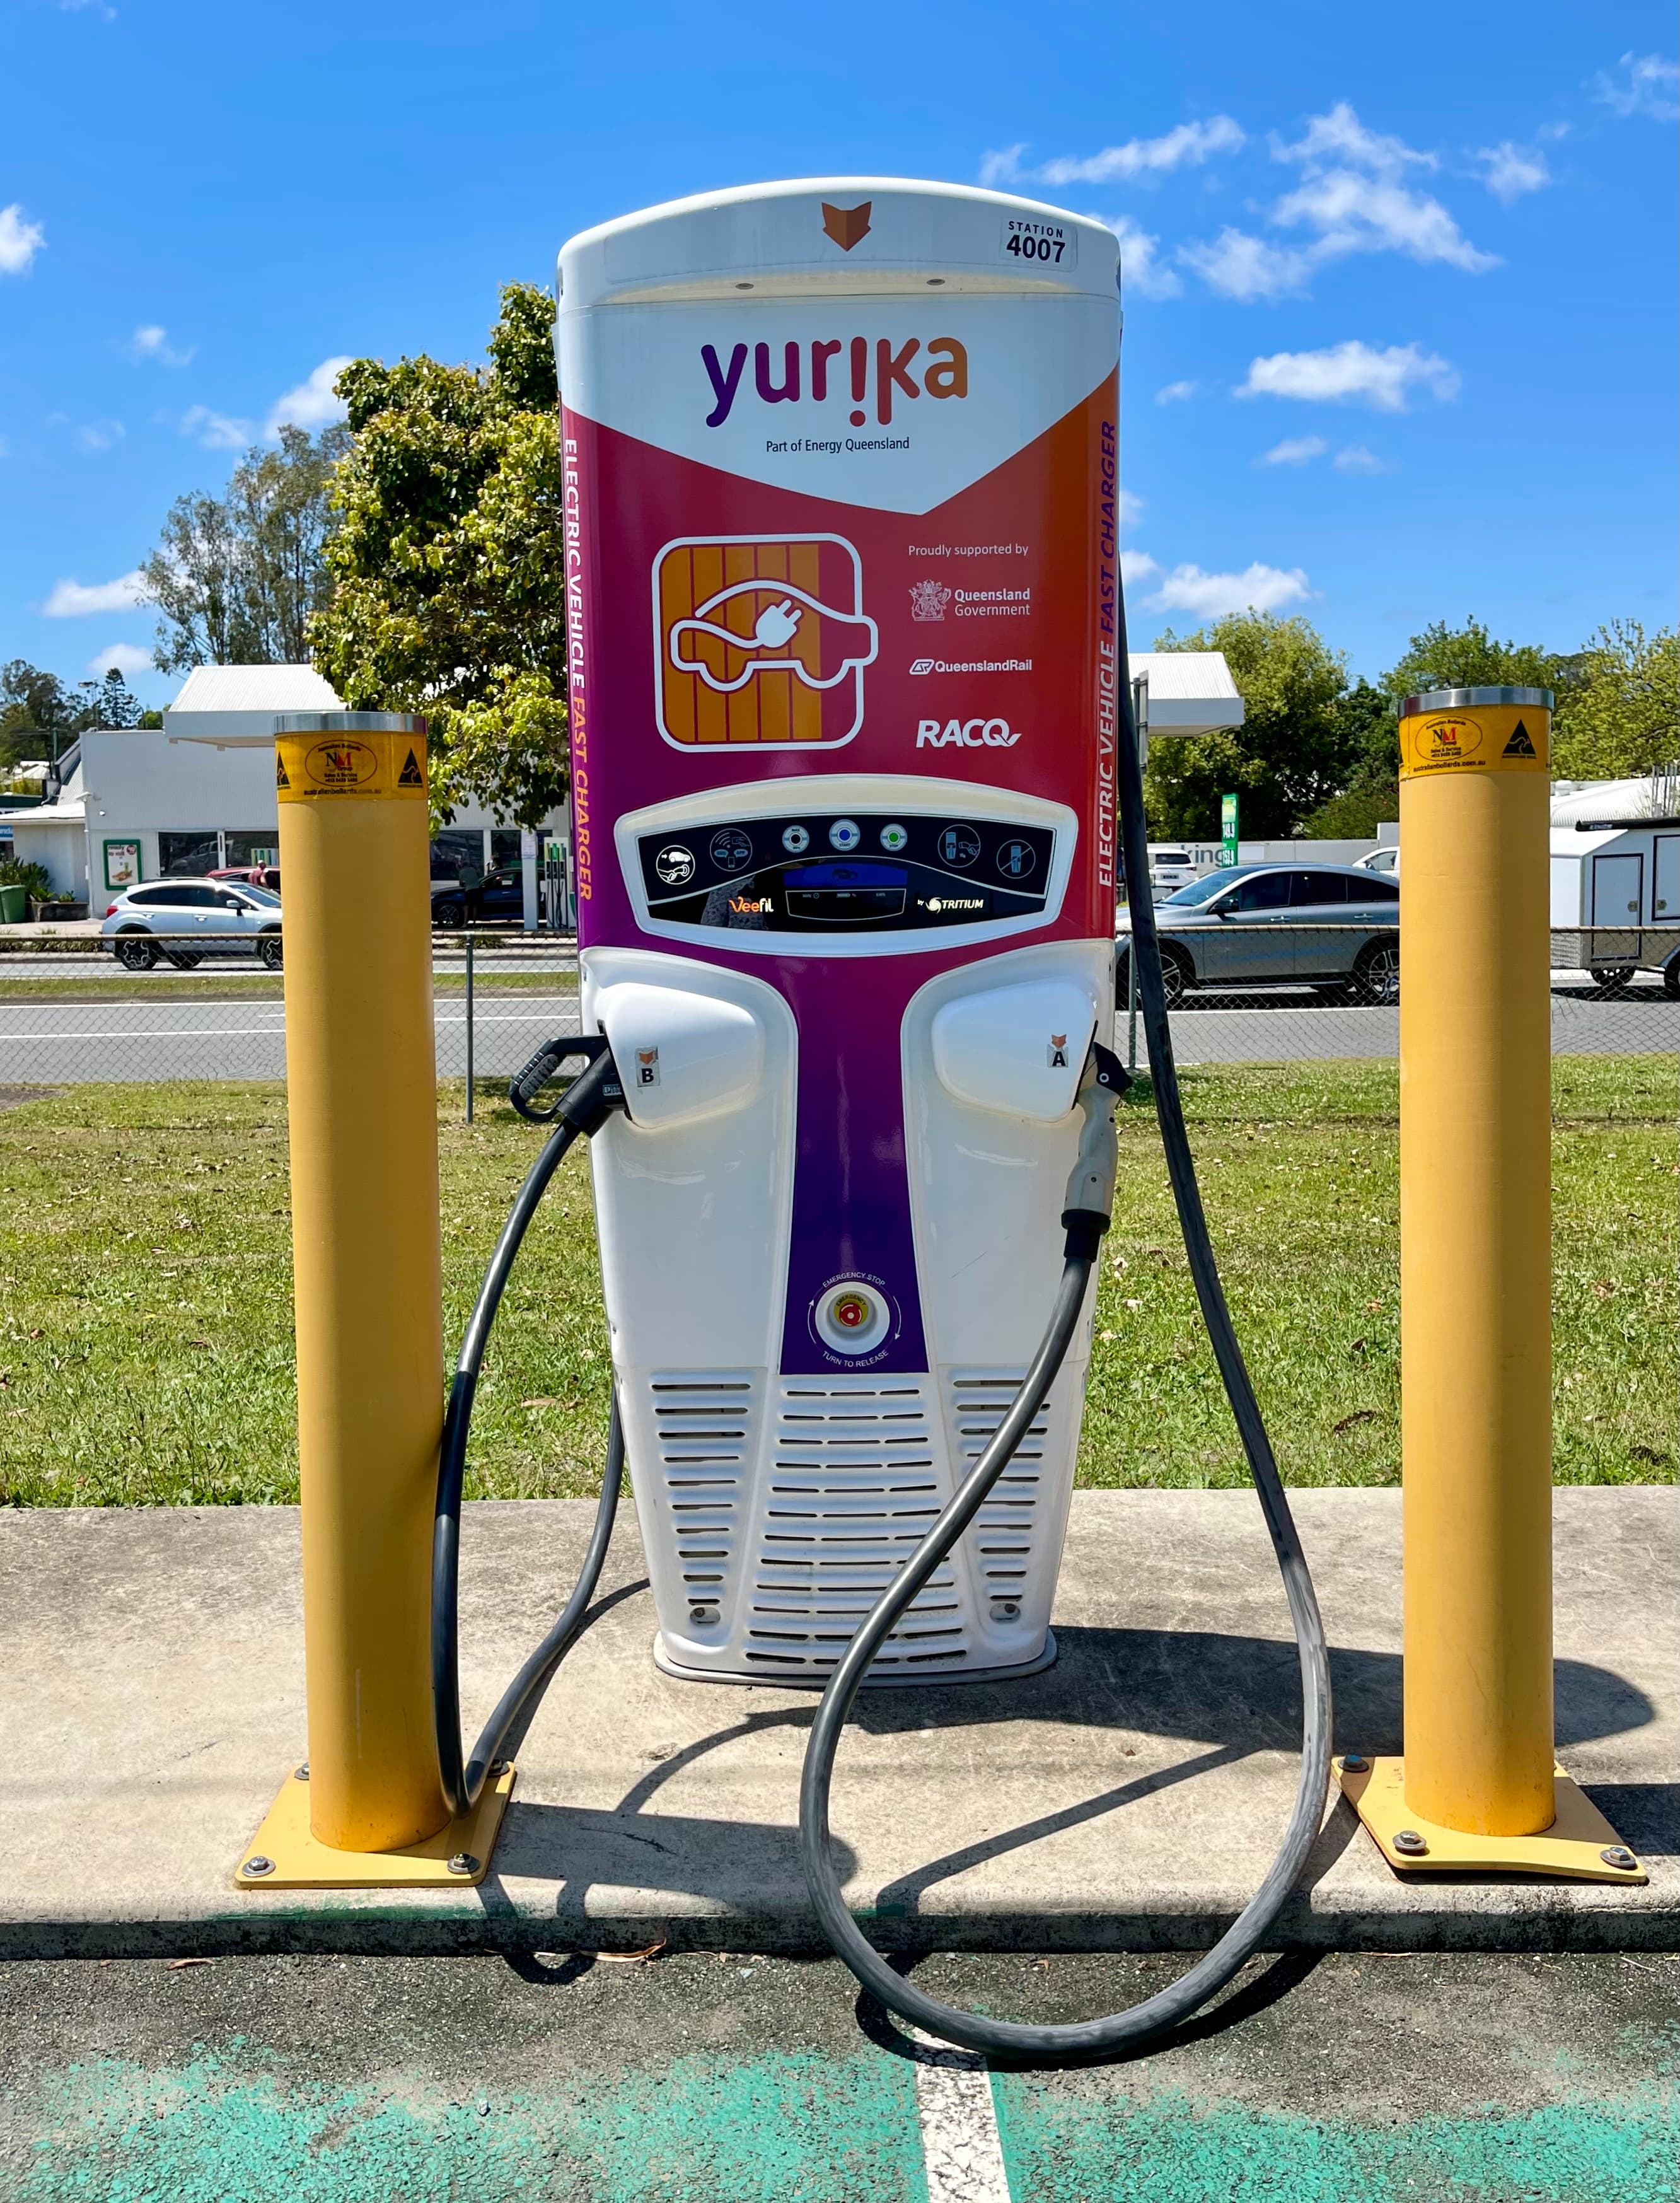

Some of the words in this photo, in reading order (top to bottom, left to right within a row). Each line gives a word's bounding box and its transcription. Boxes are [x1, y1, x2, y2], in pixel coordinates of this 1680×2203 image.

[1008, 221, 1063, 238] STATION
[1006, 235, 1065, 263] 4007
[766, 440, 788, 452] Part
[791, 439, 802, 451] of
[805, 439, 842, 453] Energy
[845, 437, 910, 451] Queensland
[1100, 421, 1115, 560] CHARGER
[565, 439, 581, 567] ELECTRIC
[908, 544, 952, 557] Proudly
[954, 543, 1012, 557] supported
[1015, 543, 1029, 556] by
[954, 588, 1031, 603] Queensland
[1100, 564, 1115, 635] FAST
[954, 603, 1031, 616] Government
[569, 574, 585, 690] VEHICLE
[1099, 640, 1115, 756] VEHICLE
[573, 695, 588, 764] FAST
[915, 718, 1022, 748] RACQ
[1099, 762, 1113, 888] ELECTRIC
[576, 769, 592, 901] CHARGER
[729, 896, 774, 913] Veefil
[941, 899, 984, 909] TRITIUM
[1051, 1051, 1066, 1067] A
[641, 1067, 654, 1084] B
[822, 1272, 866, 1288] EMERGENCY
[867, 1274, 886, 1286] STOP
[836, 1294, 867, 1307] EMERGENCY
[822, 1350, 842, 1366] TURN
[844, 1359, 854, 1368] TO
[855, 1349, 889, 1368] RELEASE
